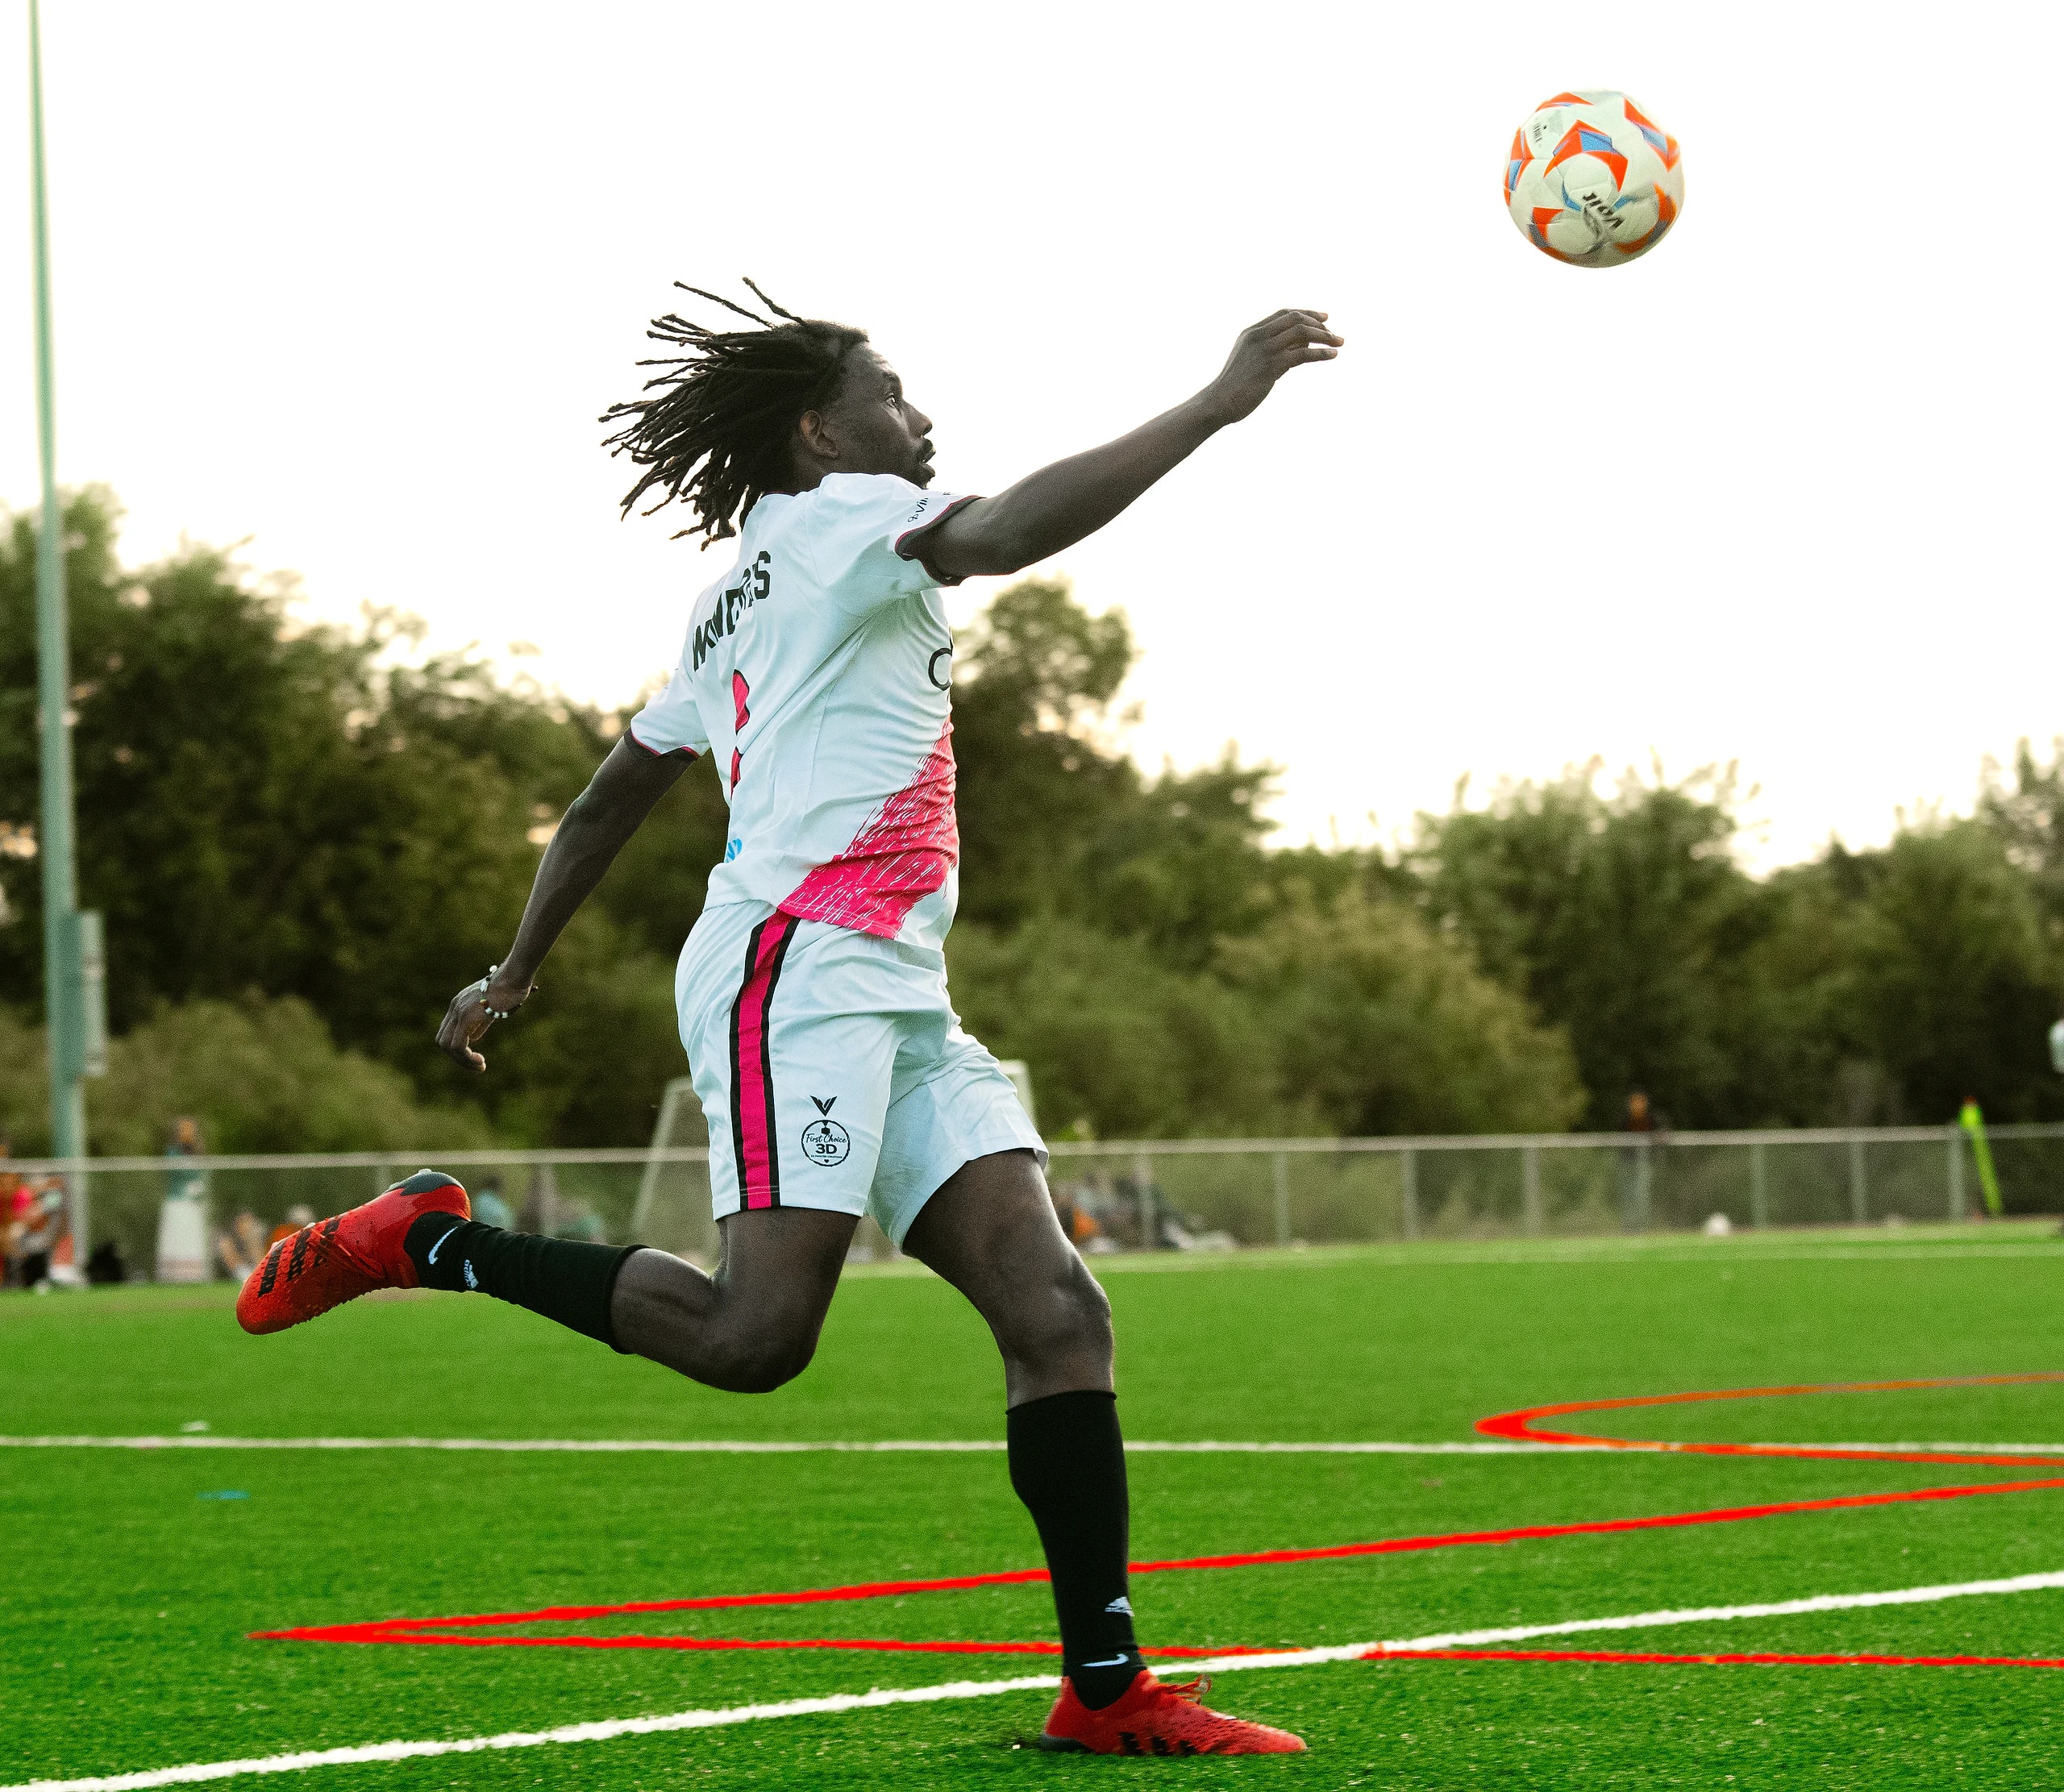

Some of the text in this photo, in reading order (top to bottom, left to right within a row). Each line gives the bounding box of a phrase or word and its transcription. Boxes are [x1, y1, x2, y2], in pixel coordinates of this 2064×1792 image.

[806, 1133, 847, 1143] First Choice
[815, 1143, 838, 1154] 3D
